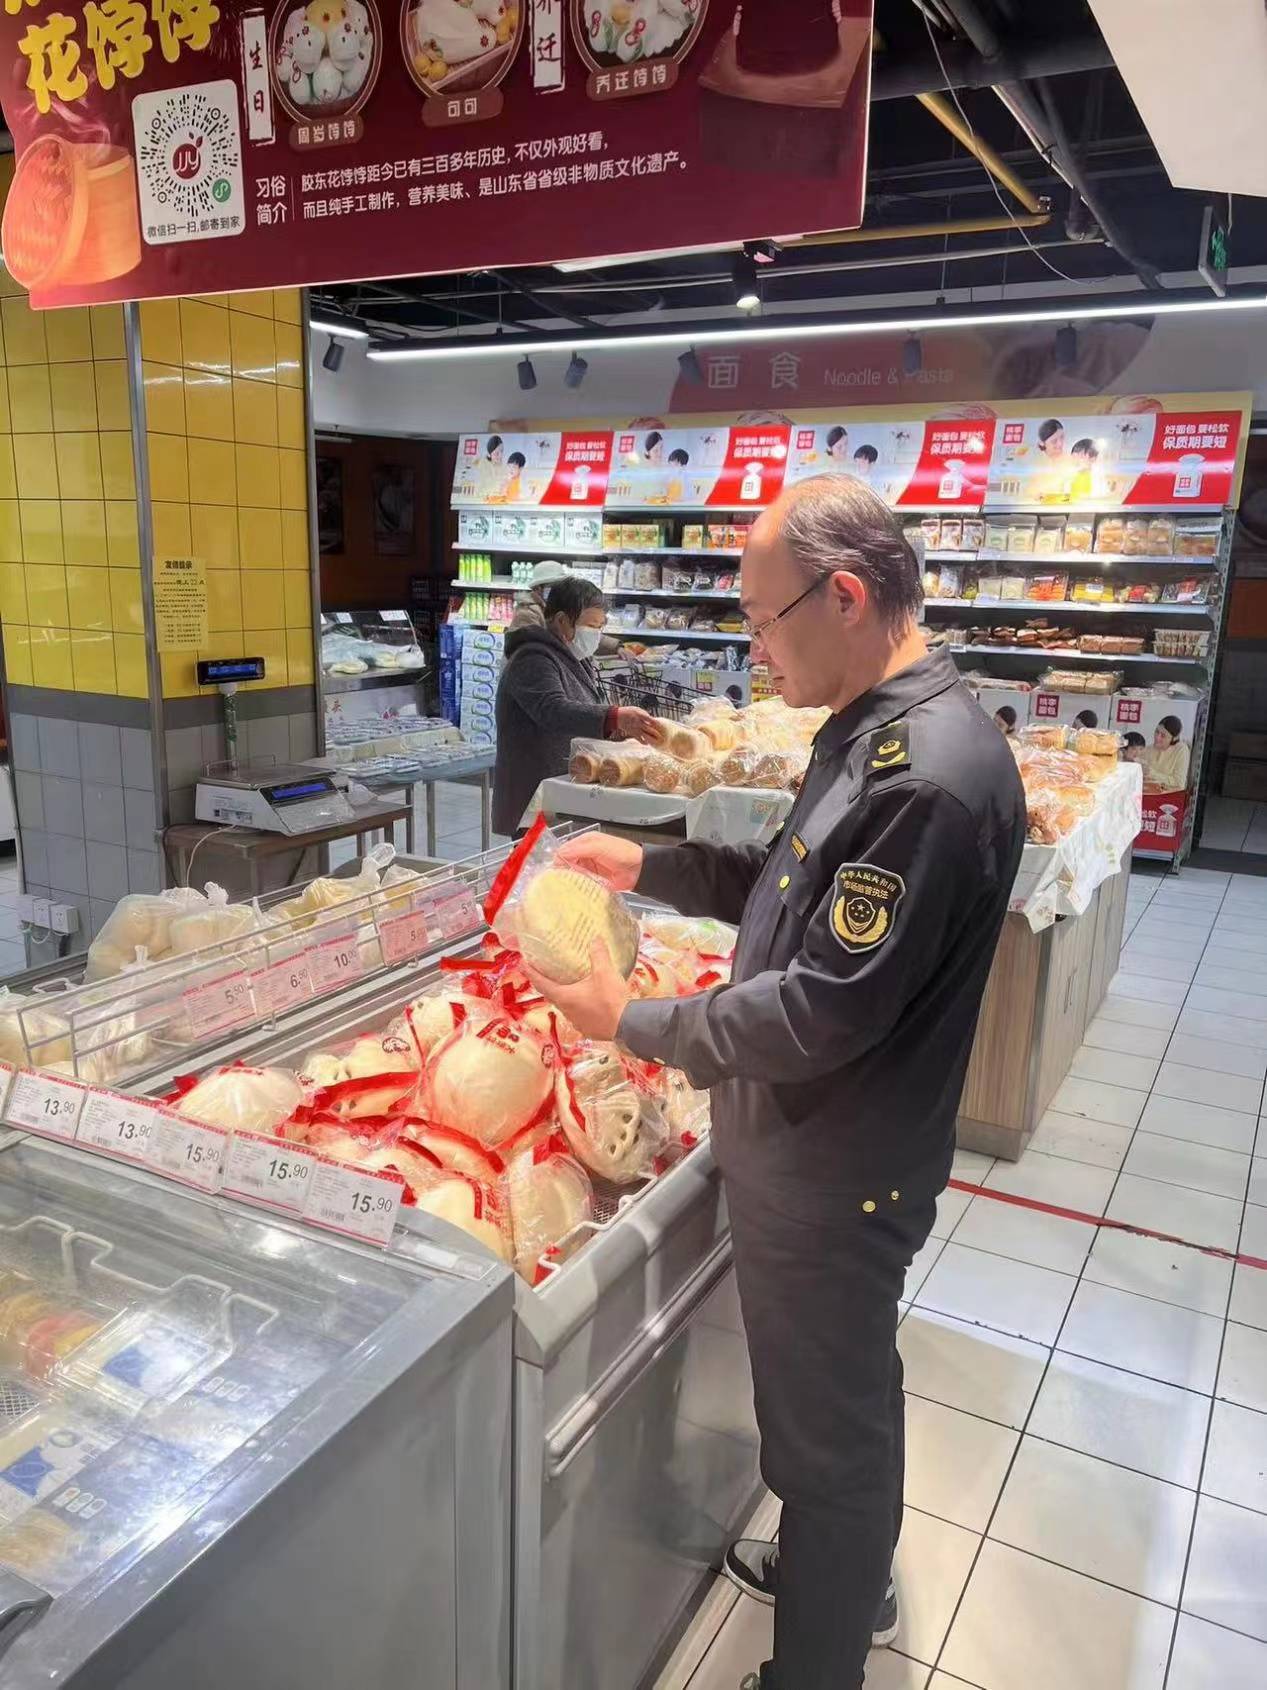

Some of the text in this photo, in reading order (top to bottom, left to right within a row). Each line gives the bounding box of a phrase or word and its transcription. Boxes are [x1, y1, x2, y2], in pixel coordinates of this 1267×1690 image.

[249, 40, 263, 113] 生日
[256, 175, 287, 198] 习俗
[256, 202, 287, 225] 简介
[824, 368, 881, 386] Noodle
[887, 368, 898, 385] &
[1163, 435, 1228, 450] 保质期要短
[44, 1098, 75, 1116] 13.90
[118, 1121, 154, 1140] 13.90
[186, 1143, 220, 1163] 15.90
[269, 1159, 308, 1180] 15.90
[352, 1192, 393, 1213] 15.90
